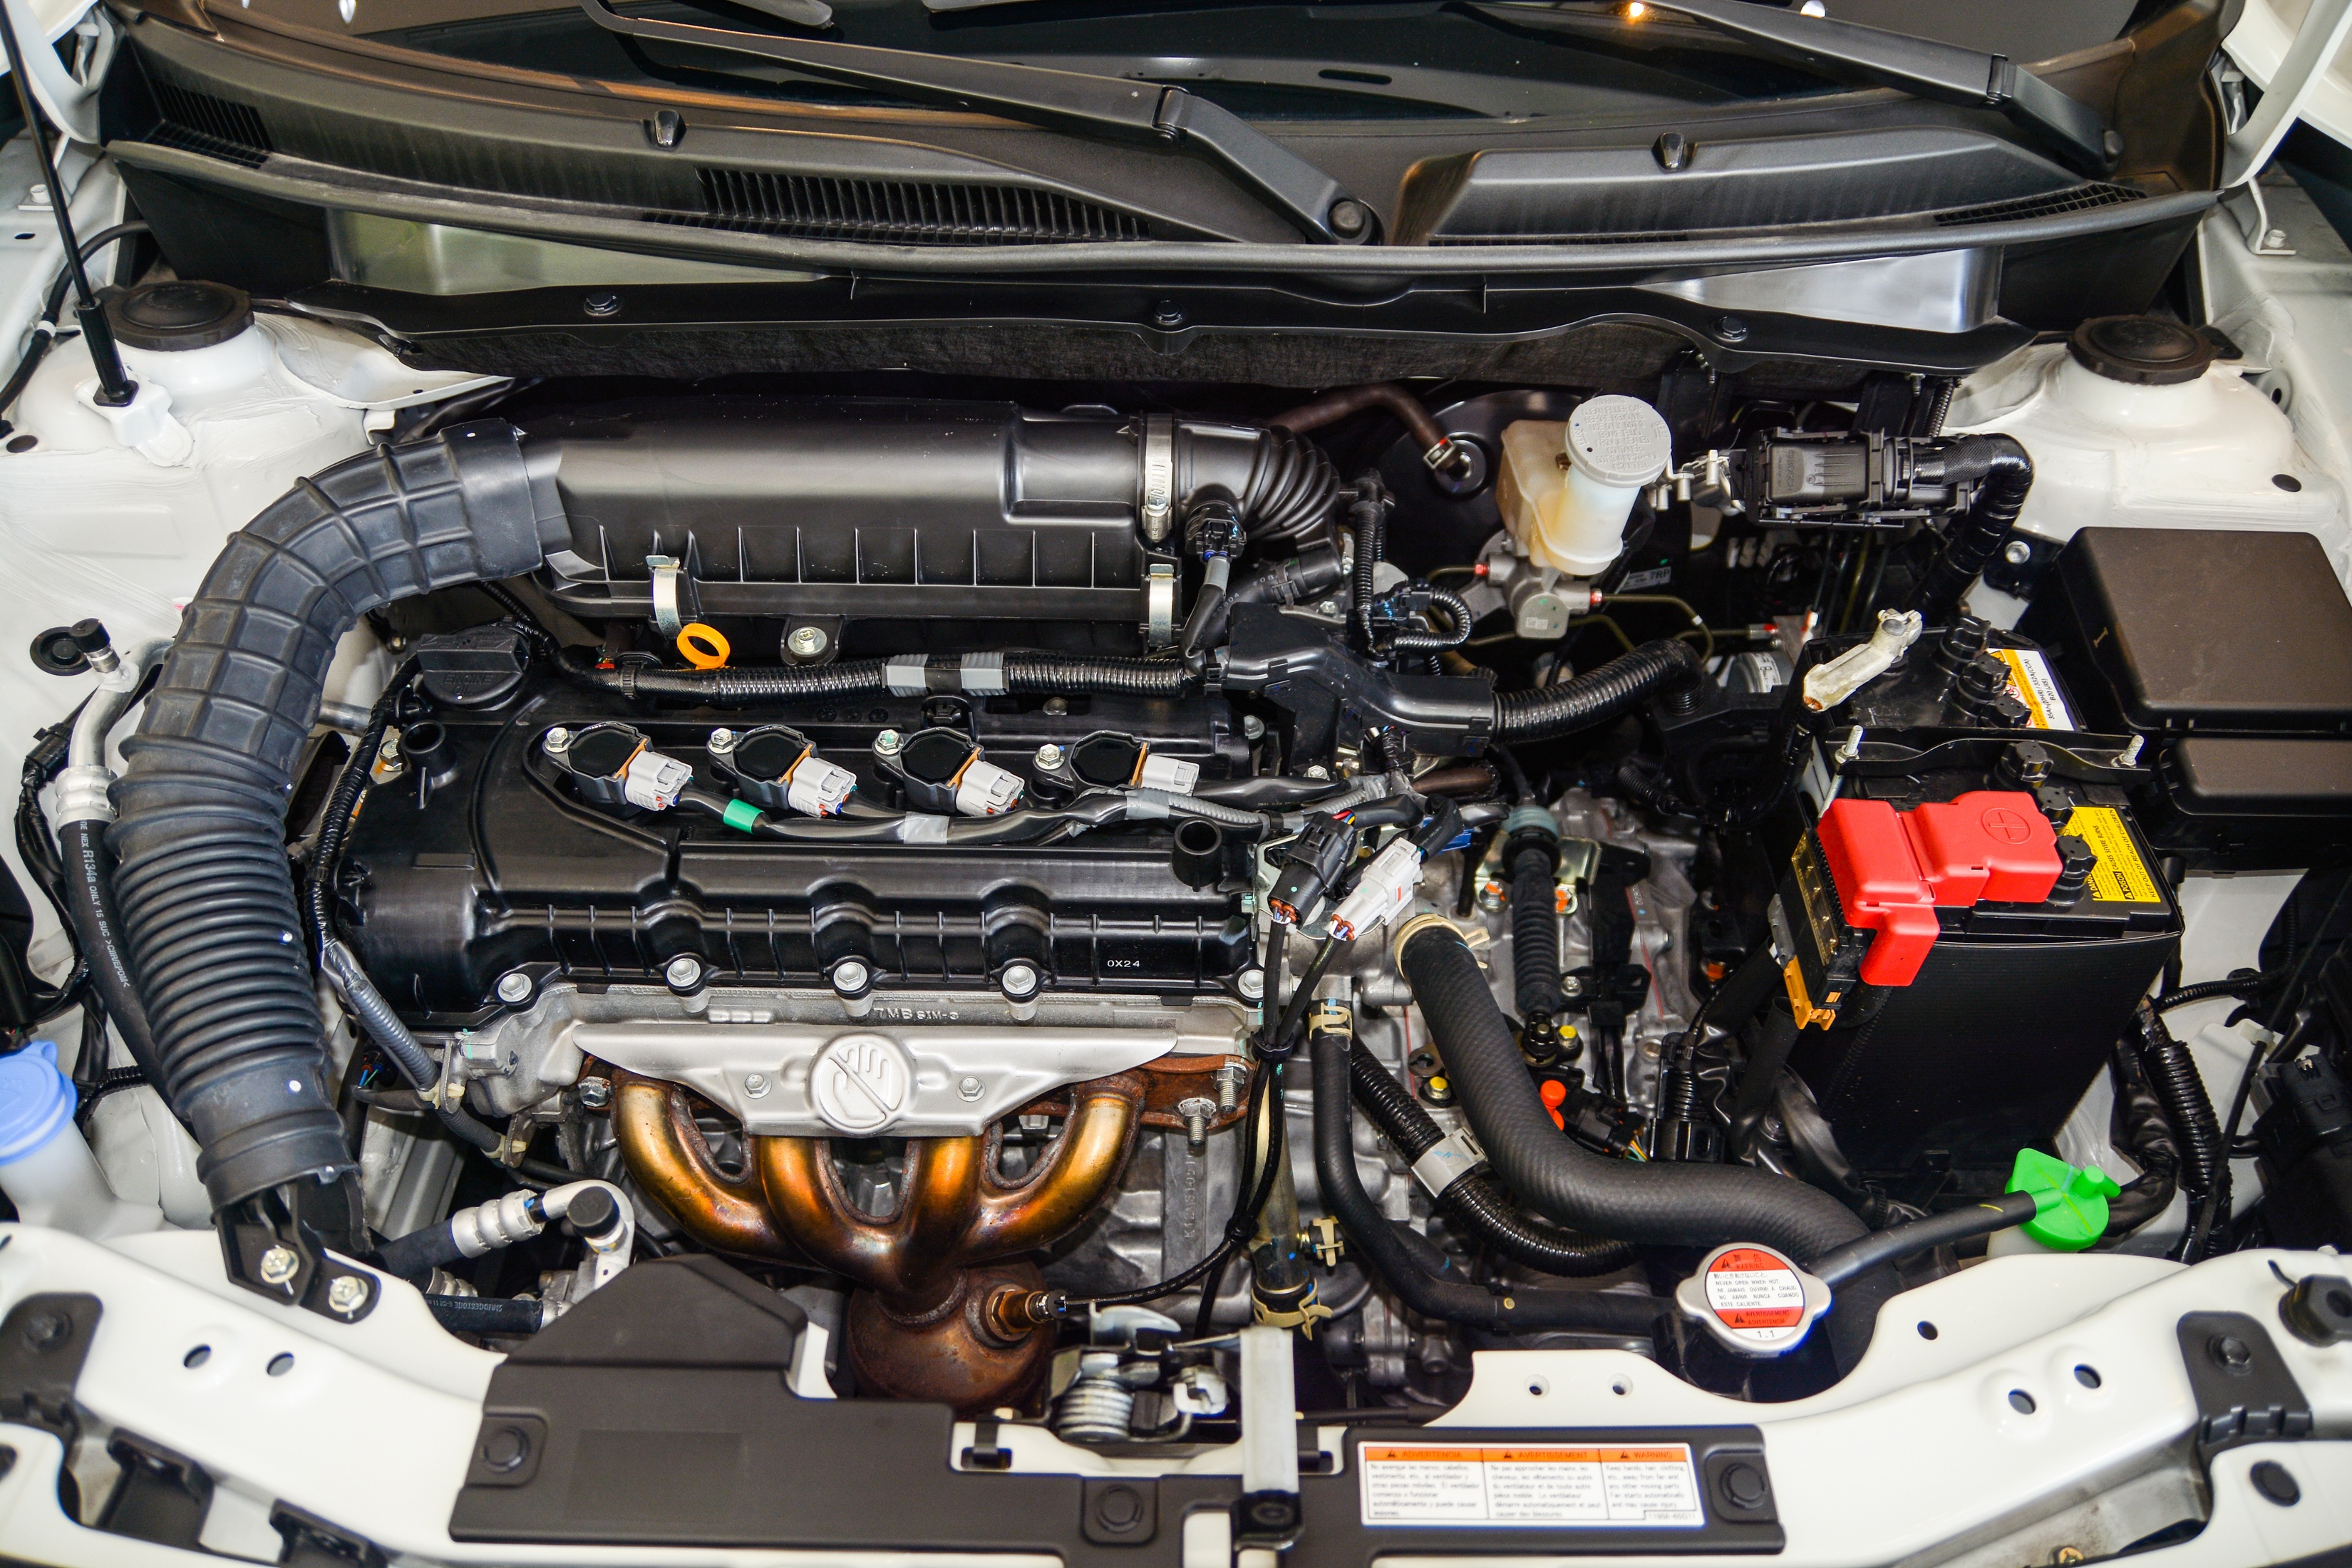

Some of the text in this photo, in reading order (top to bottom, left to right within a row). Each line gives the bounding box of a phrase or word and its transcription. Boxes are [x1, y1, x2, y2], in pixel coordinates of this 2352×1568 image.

[1787, 459, 1795, 490] BOSCH
[2108, 809, 2125, 835] CHILDREN
[2092, 825, 2104, 838] BURNS
[2098, 840, 2111, 852] SEVERE
[2125, 843, 2138, 861] REACH
[83, 850, 98, 882] R134a
[2106, 855, 2119, 870] CAUSES
[2114, 872, 2130, 891] POISON
[2138, 871, 2149, 882] OUT
[89, 886, 100, 906] ONLY
[2144, 882, 2157, 897] KEEP
[96, 909, 104, 918] 15
[98, 921, 110, 937] SUC
